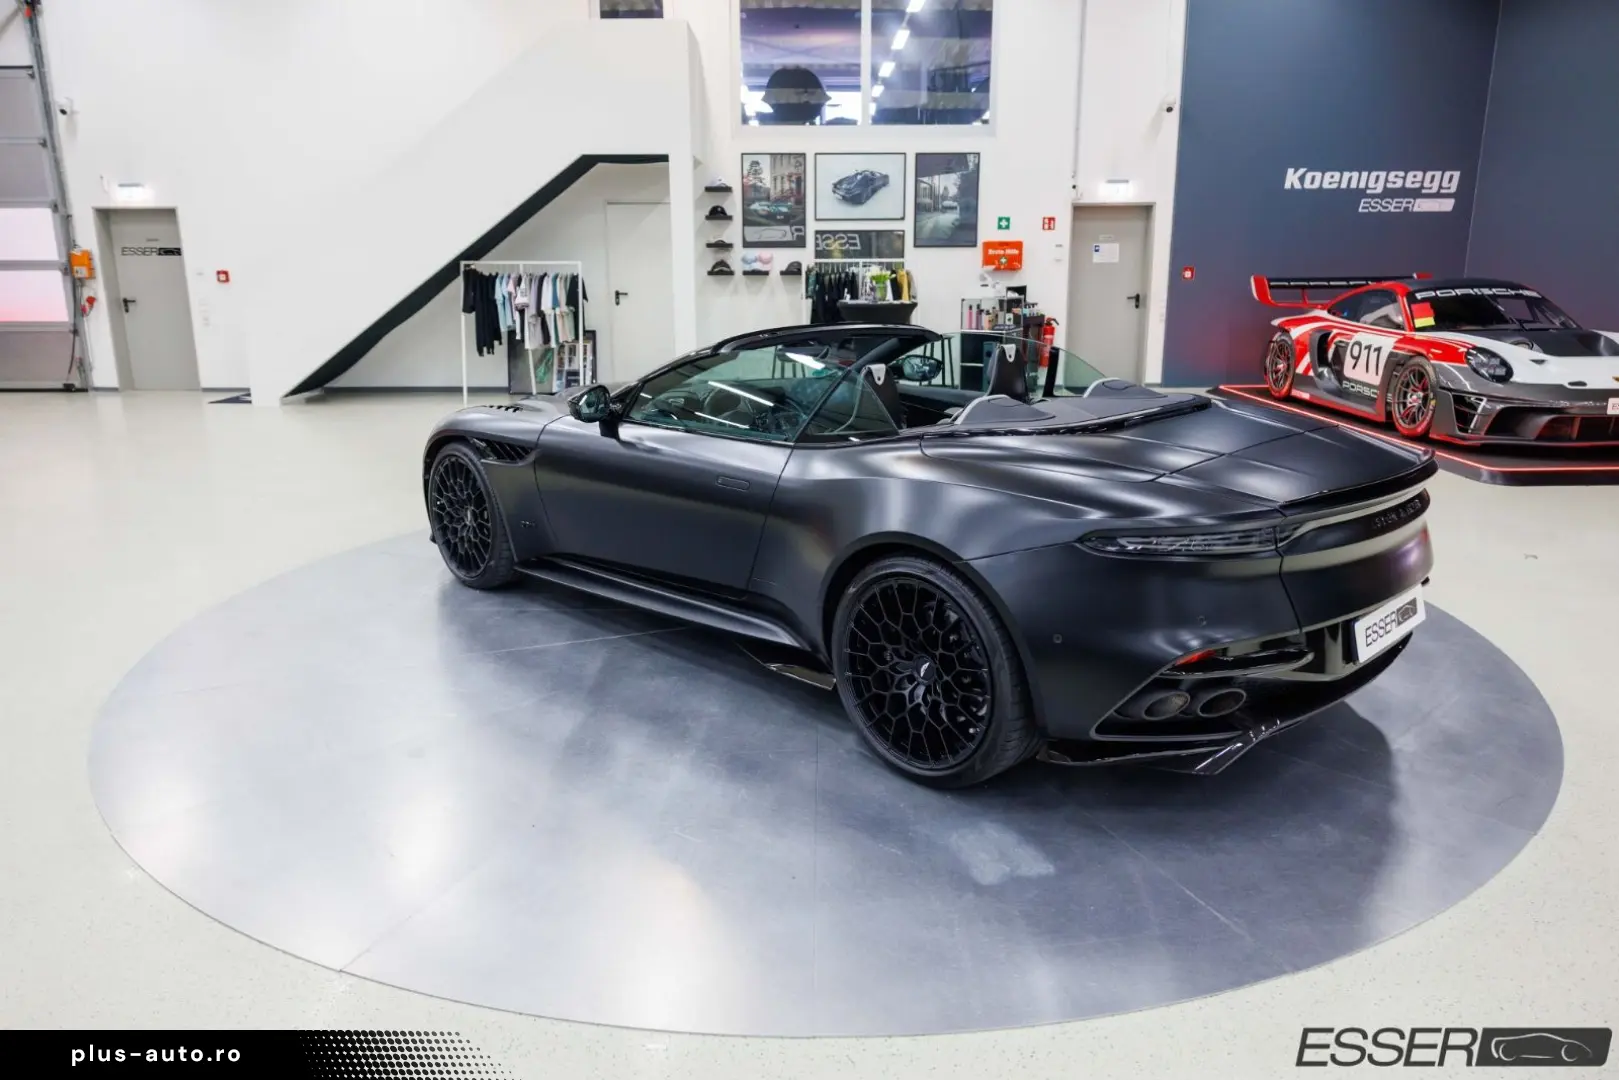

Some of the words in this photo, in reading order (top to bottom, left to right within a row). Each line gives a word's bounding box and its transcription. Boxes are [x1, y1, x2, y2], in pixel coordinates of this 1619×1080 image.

[1284, 168, 1461, 194] Koenigsegg
[1358, 198, 1415, 213] ESSER
[120, 246, 158, 256] ESSER
[1414, 287, 1542, 300] PORSCHE
[1350, 340, 1382, 376] 911
[1365, 610, 1397, 647] ESSER
